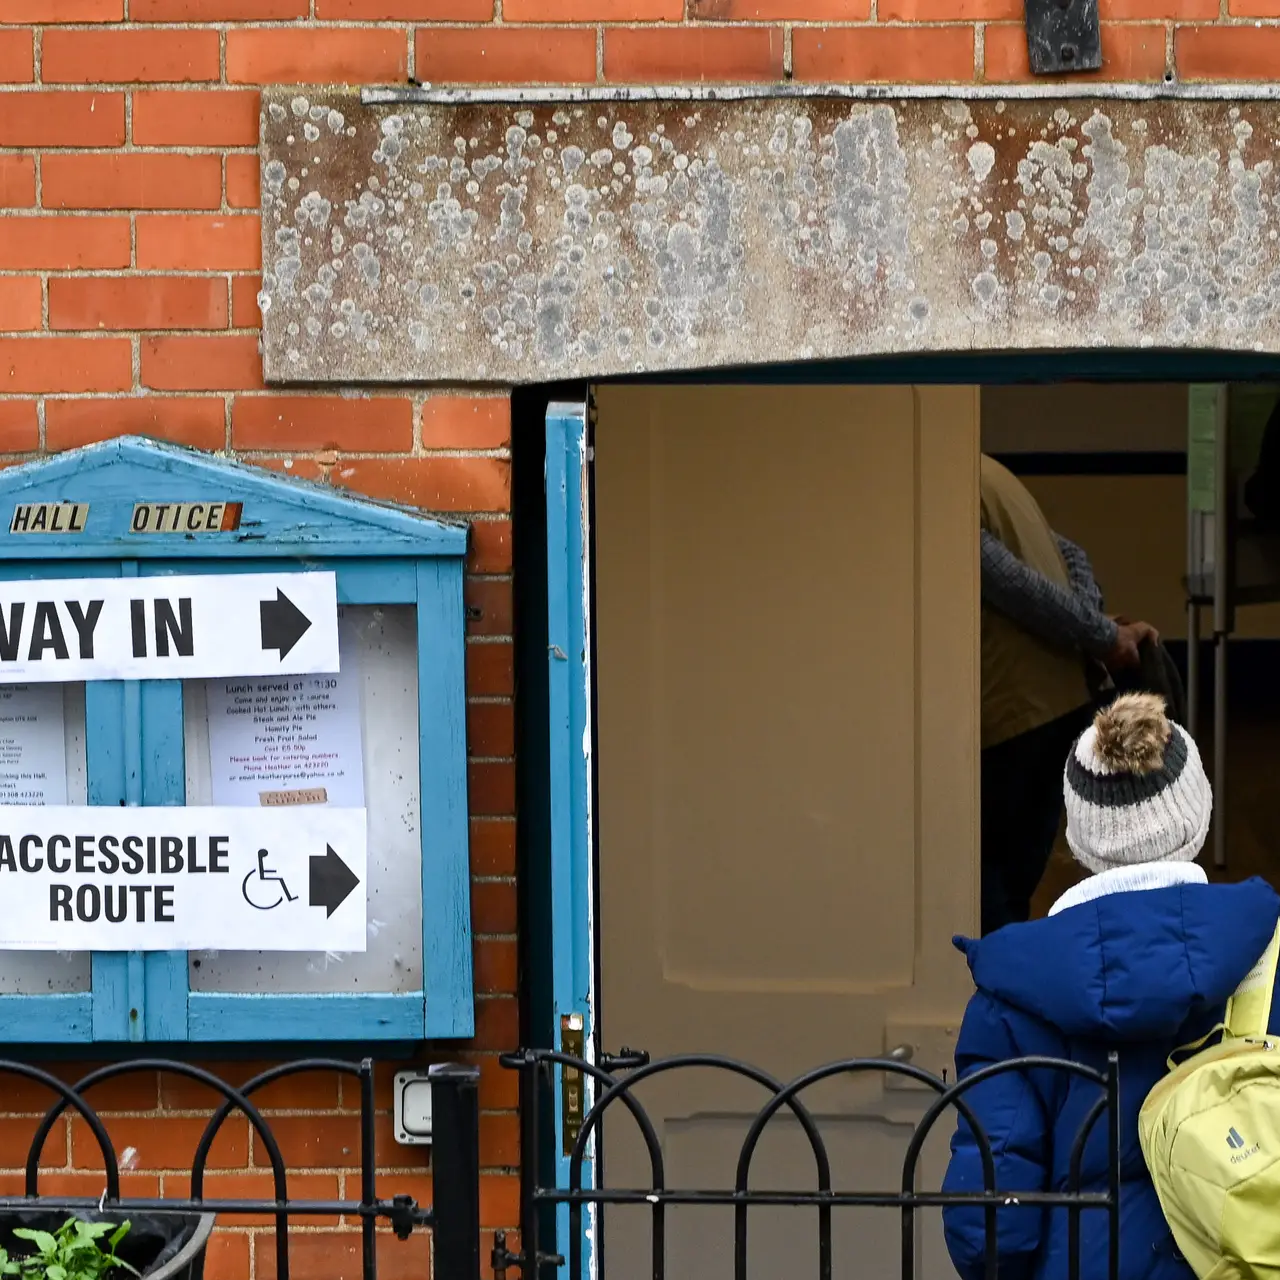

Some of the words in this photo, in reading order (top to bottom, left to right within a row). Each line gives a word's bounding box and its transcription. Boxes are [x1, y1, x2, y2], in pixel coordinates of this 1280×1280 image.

[12, 504, 83, 531] HALL
[132, 504, 223, 531] OTICE
[130, 597, 195, 658] IN
[225, 683, 253, 694] Lunch
[257, 681, 289, 692] served
[293, 681, 304, 691] at
[49, 884, 176, 923] ROUTE
